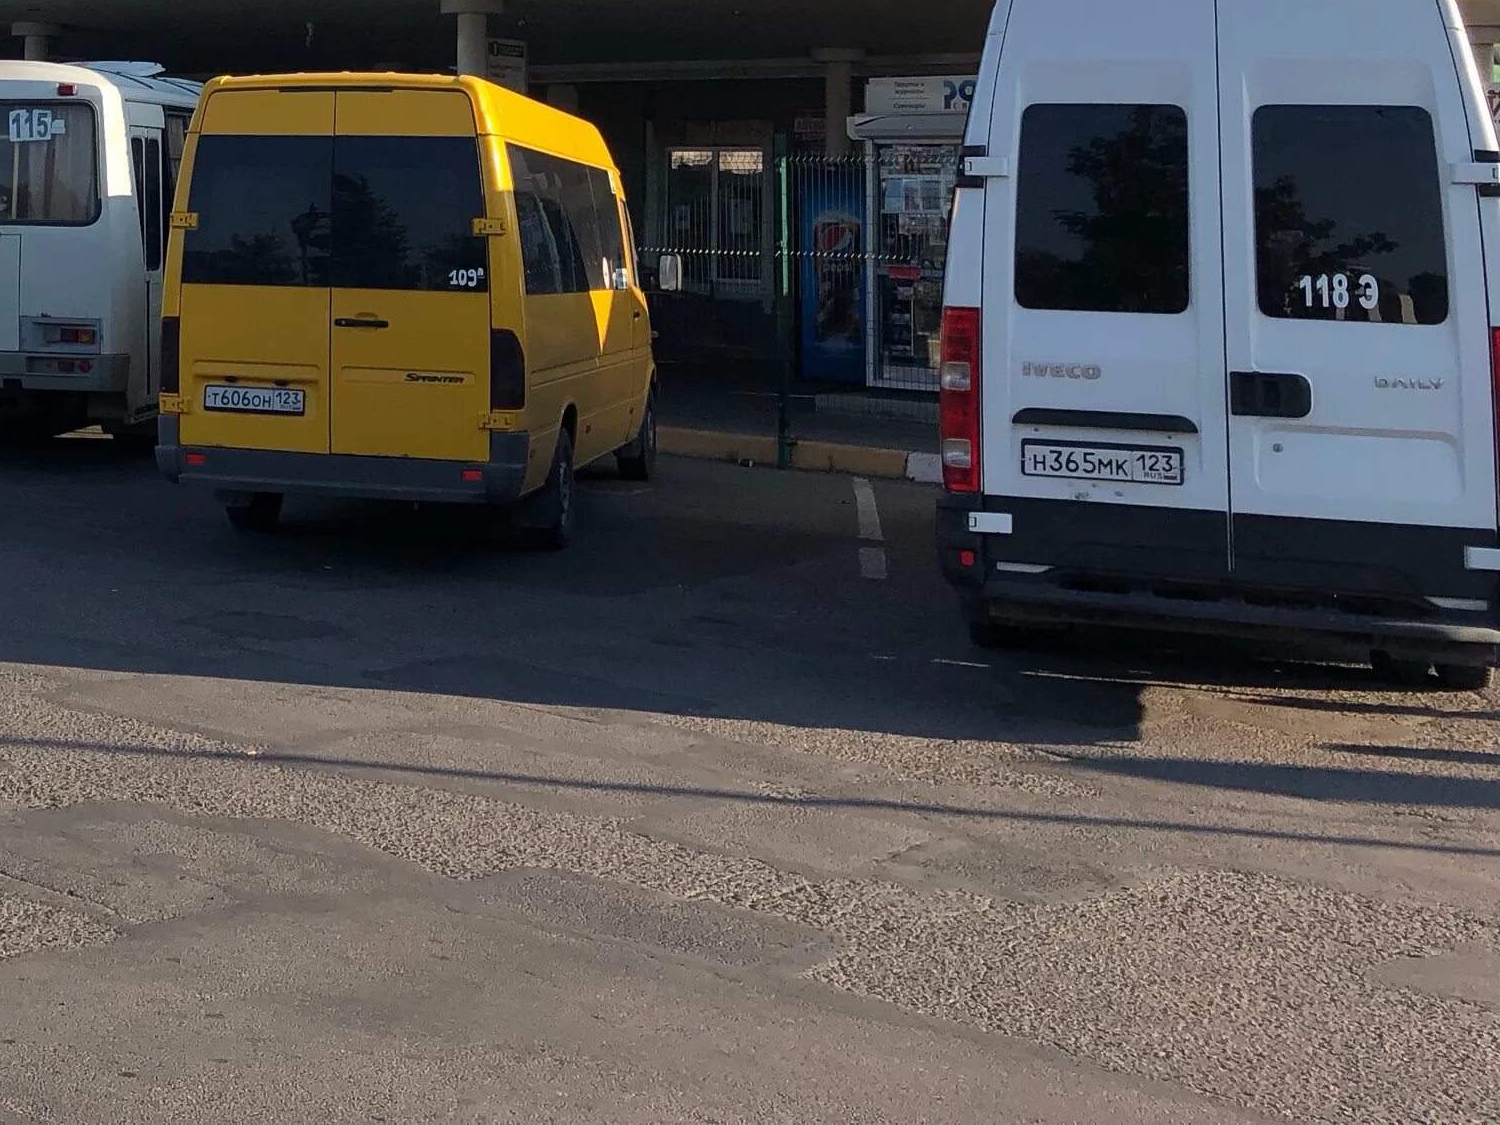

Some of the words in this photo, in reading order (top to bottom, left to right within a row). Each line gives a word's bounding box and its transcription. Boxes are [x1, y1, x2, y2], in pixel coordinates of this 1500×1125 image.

[12, 112, 49, 139] 115
[1300, 273, 1350, 308] 118
[1022, 362, 1101, 380] IVECO
[1374, 376, 1444, 390] DAILY
[211, 390, 272, 409] Т606ОН
[275, 391, 300, 405] 123
[1032, 449, 1129, 477] Н365МК
[1136, 453, 1174, 473] 123
[1143, 471, 1163, 480] RUS
